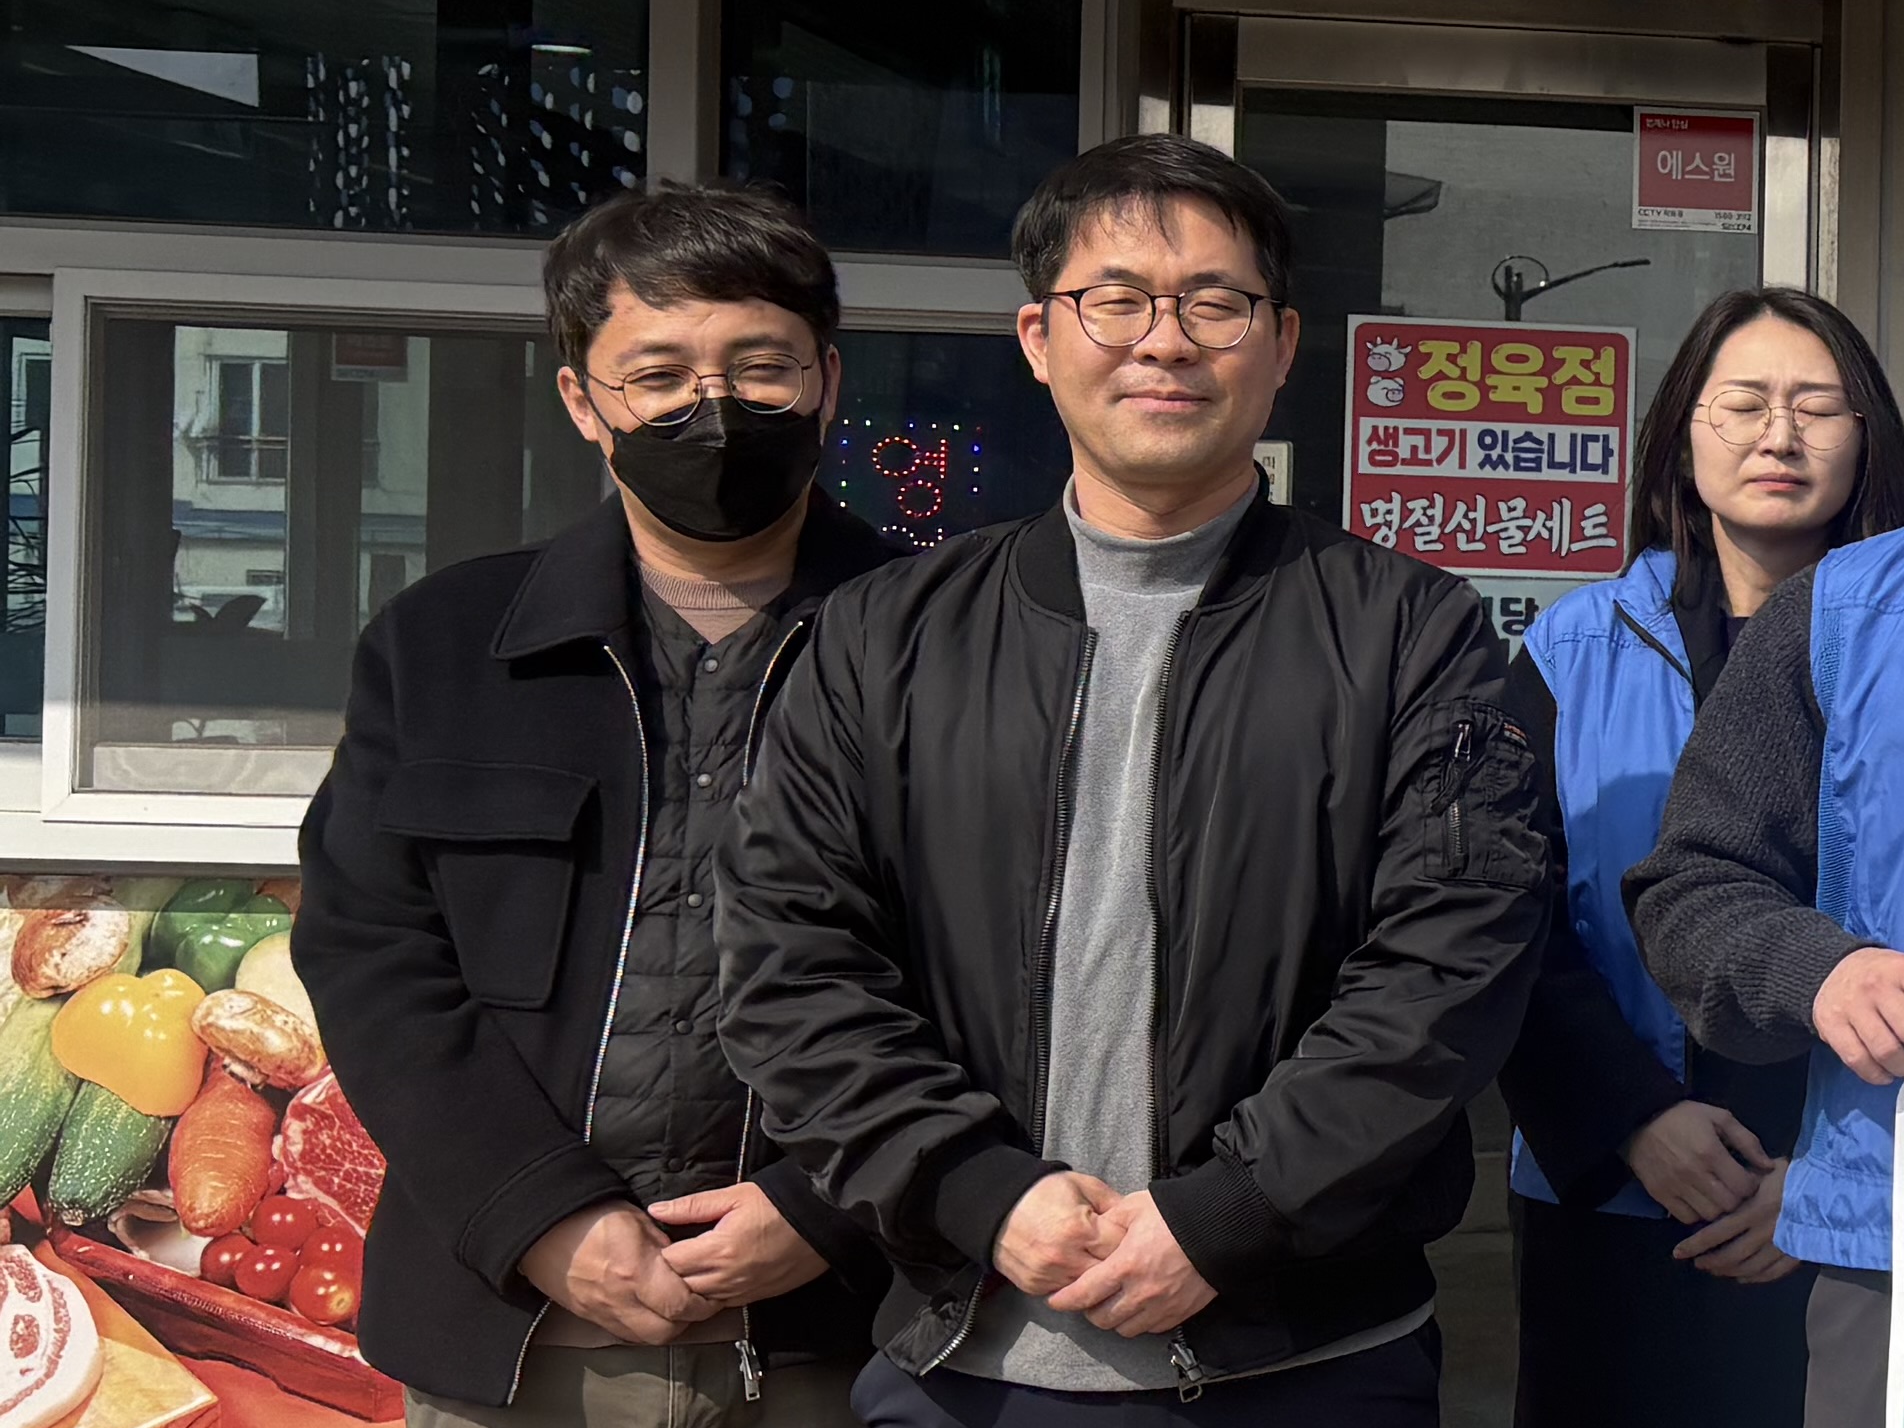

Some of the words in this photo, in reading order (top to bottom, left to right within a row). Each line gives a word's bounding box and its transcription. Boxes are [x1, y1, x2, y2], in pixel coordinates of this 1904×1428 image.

[1657, 150, 1736, 182] 에스원
[1416, 339, 1616, 417] 정육점
[1366, 424, 1468, 471] 생고기
[1477, 428, 1615, 476] 있습니다
